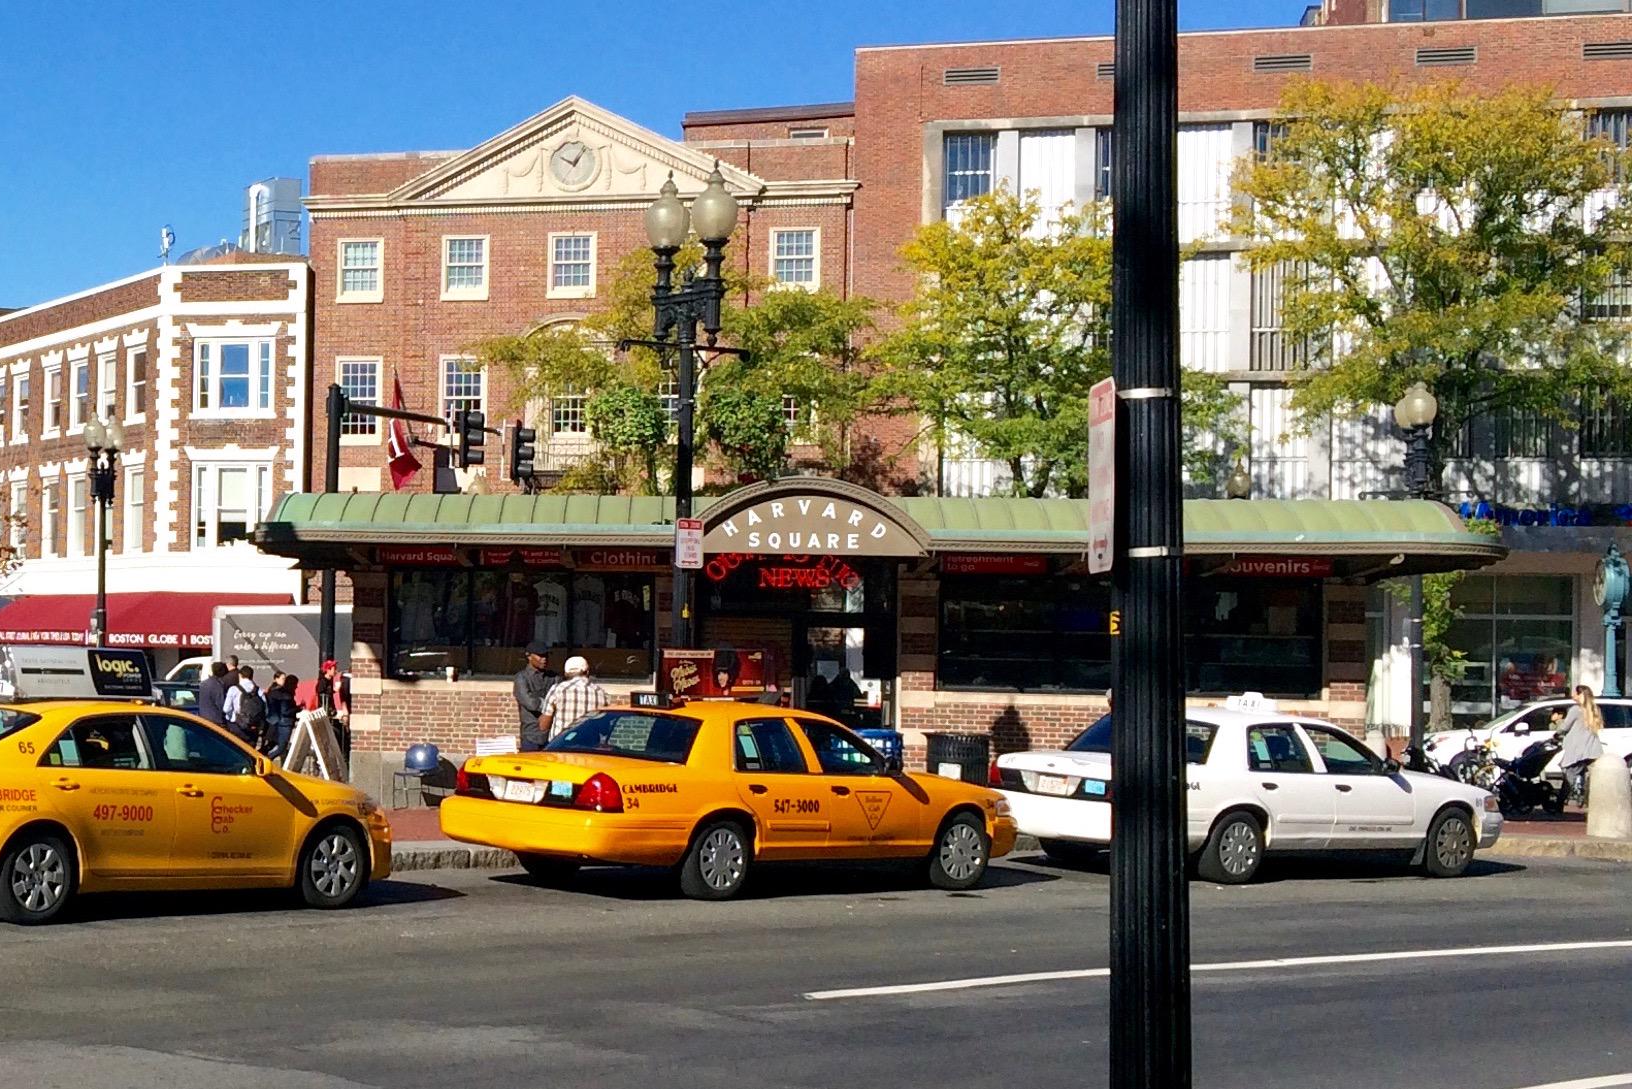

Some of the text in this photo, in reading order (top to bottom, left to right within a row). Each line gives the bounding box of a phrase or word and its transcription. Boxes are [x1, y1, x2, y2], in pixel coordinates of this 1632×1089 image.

[721, 500, 887, 539] HARVARD
[748, 532, 860, 550] SQUARE
[382, 550, 424, 561] Harvard
[1230, 559, 1311, 574] ouvenirs
[758, 567, 832, 588] NEWS
[108, 632, 145, 645] BOSTON
[148, 633, 178, 645] GLOBE
[261, 642, 300, 653] difference
[94, 654, 140, 678] logic.
[639, 694, 659, 706] TAXI
[1238, 699, 1261, 708] TAXI
[18, 742, 36, 755] 65
[622, 783, 679, 794] CAMBRIDGE
[5, 804, 38, 812] COURIER
[211, 796, 254, 815] Checker
[626, 797, 640, 809] 34
[774, 799, 820, 813] 547-3000
[93, 804, 154, 822] 497-9000
